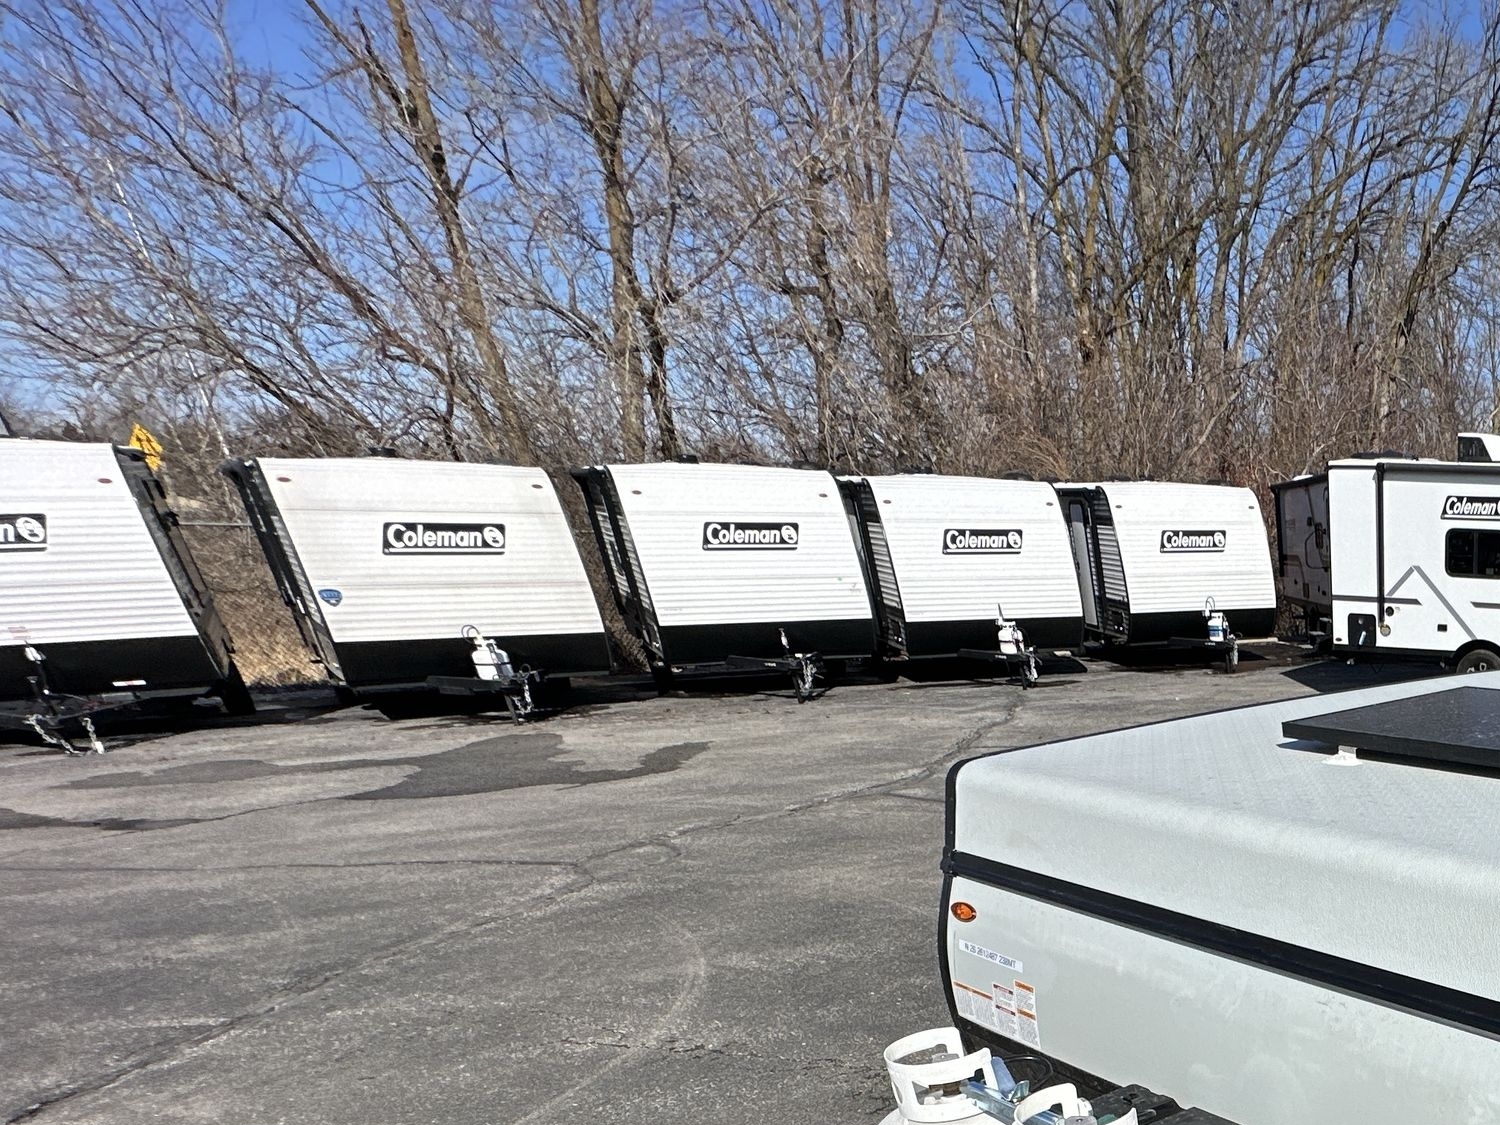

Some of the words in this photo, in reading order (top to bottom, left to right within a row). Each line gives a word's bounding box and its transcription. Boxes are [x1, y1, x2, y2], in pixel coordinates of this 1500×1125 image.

[1445, 496, 1496, 515] Coleman
[387, 523, 482, 548] Coleman
[706, 523, 780, 544] Coleman
[946, 530, 1007, 549] Coleman
[1163, 531, 1213, 548] Coleman
